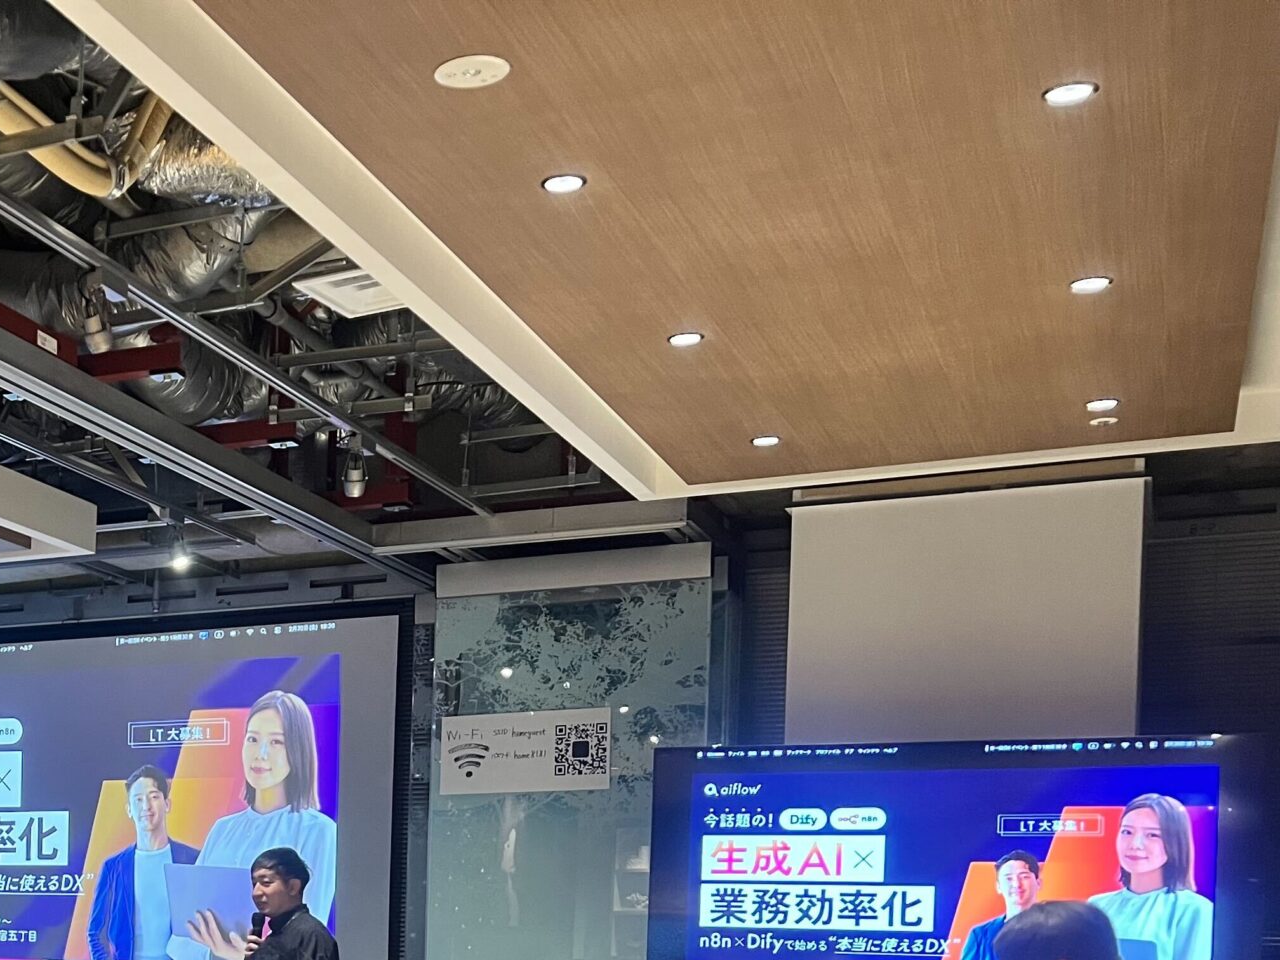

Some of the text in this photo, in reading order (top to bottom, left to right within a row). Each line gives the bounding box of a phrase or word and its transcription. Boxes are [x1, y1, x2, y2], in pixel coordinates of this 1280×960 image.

[0, 728, 15, 736] n8n
[150, 729, 164, 742] LT
[446, 728, 484, 741] Wi-Fi
[720, 782, 762, 796] aiflow
[790, 814, 818, 827] Dify
[1019, 820, 1035, 832] LT
[710, 887, 923, 927] 業務効率化
